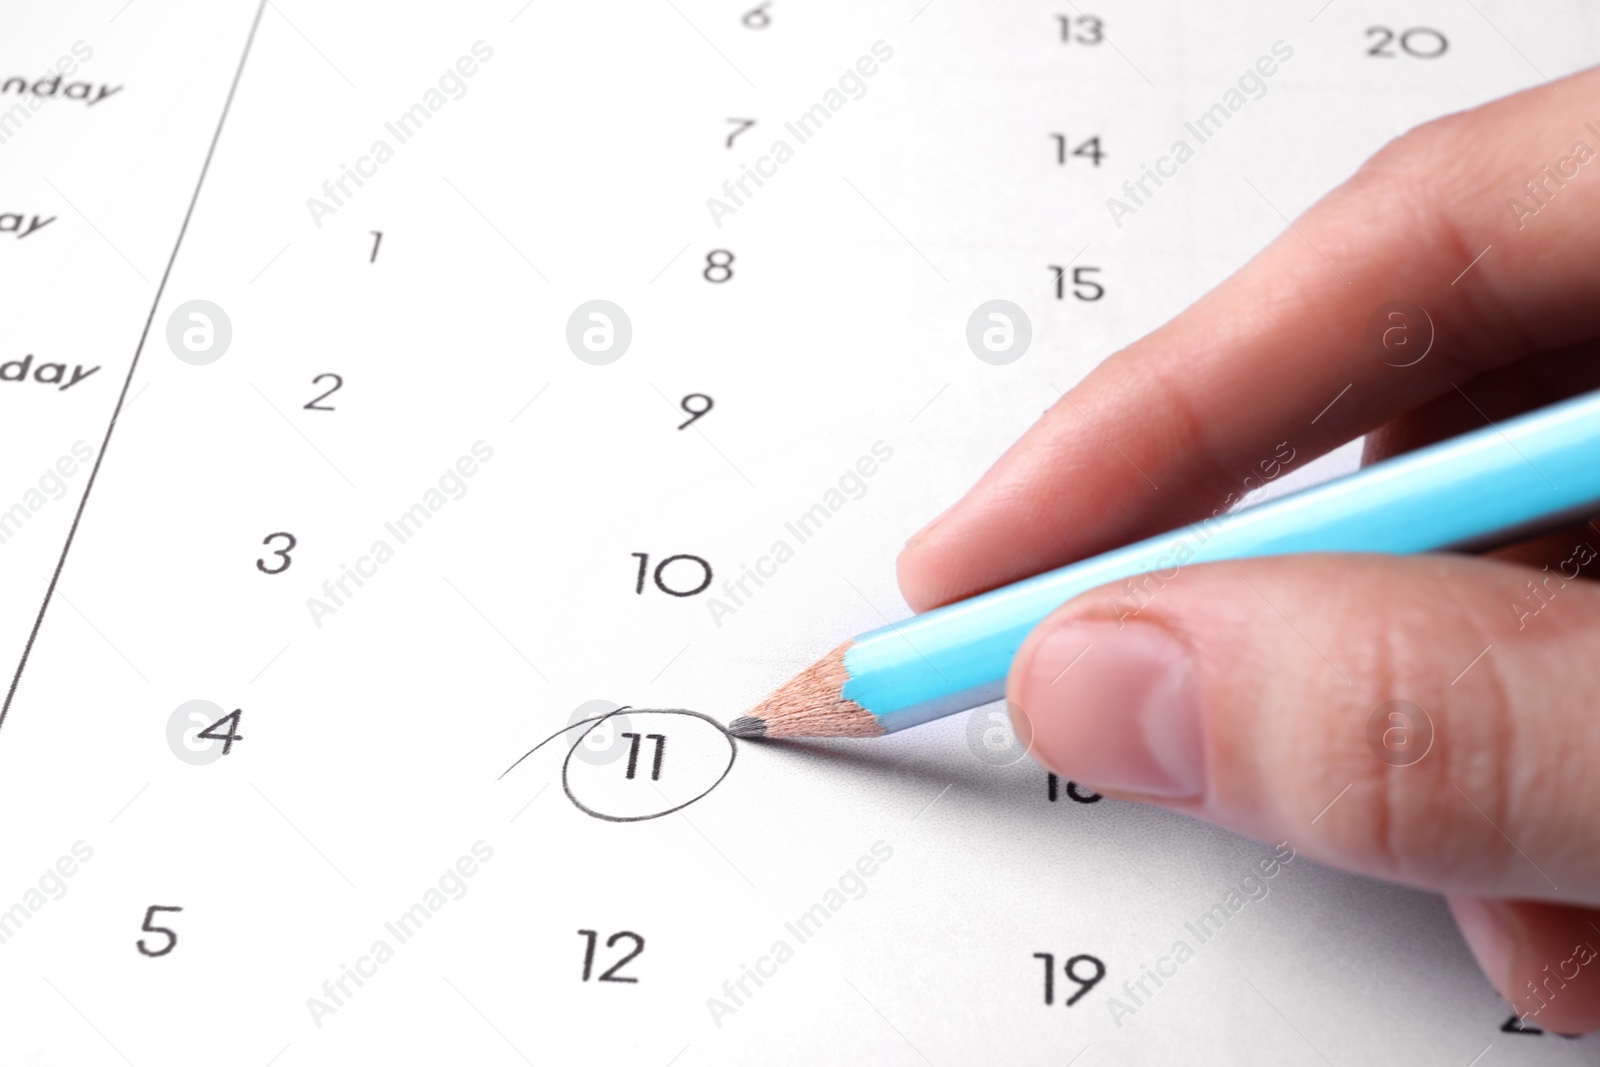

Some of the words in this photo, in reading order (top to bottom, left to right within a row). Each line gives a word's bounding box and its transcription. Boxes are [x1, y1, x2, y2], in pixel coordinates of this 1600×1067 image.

[740, 0, 773, 30] 6
[1055, 13, 1105, 46] 13
[1365, 26, 1450, 60] 20
[725, 118, 756, 149] 7
[1051, 132, 1107, 167] 14
[368, 230, 384, 264] 1
[702, 249, 736, 284] 8
[1048, 265, 1105, 302] 15
[0, 353, 101, 391] day
[302, 372, 344, 412] 2
[677, 393, 715, 431] 9
[256, 531, 297, 575] 3
[630, 552, 714, 598] 10
[196, 708, 244, 756] 4
[620, 732, 666, 782] 11
[135, 904, 184, 958] 5
[577, 929, 646, 984] 12
[1032, 952, 1107, 1008] 19
